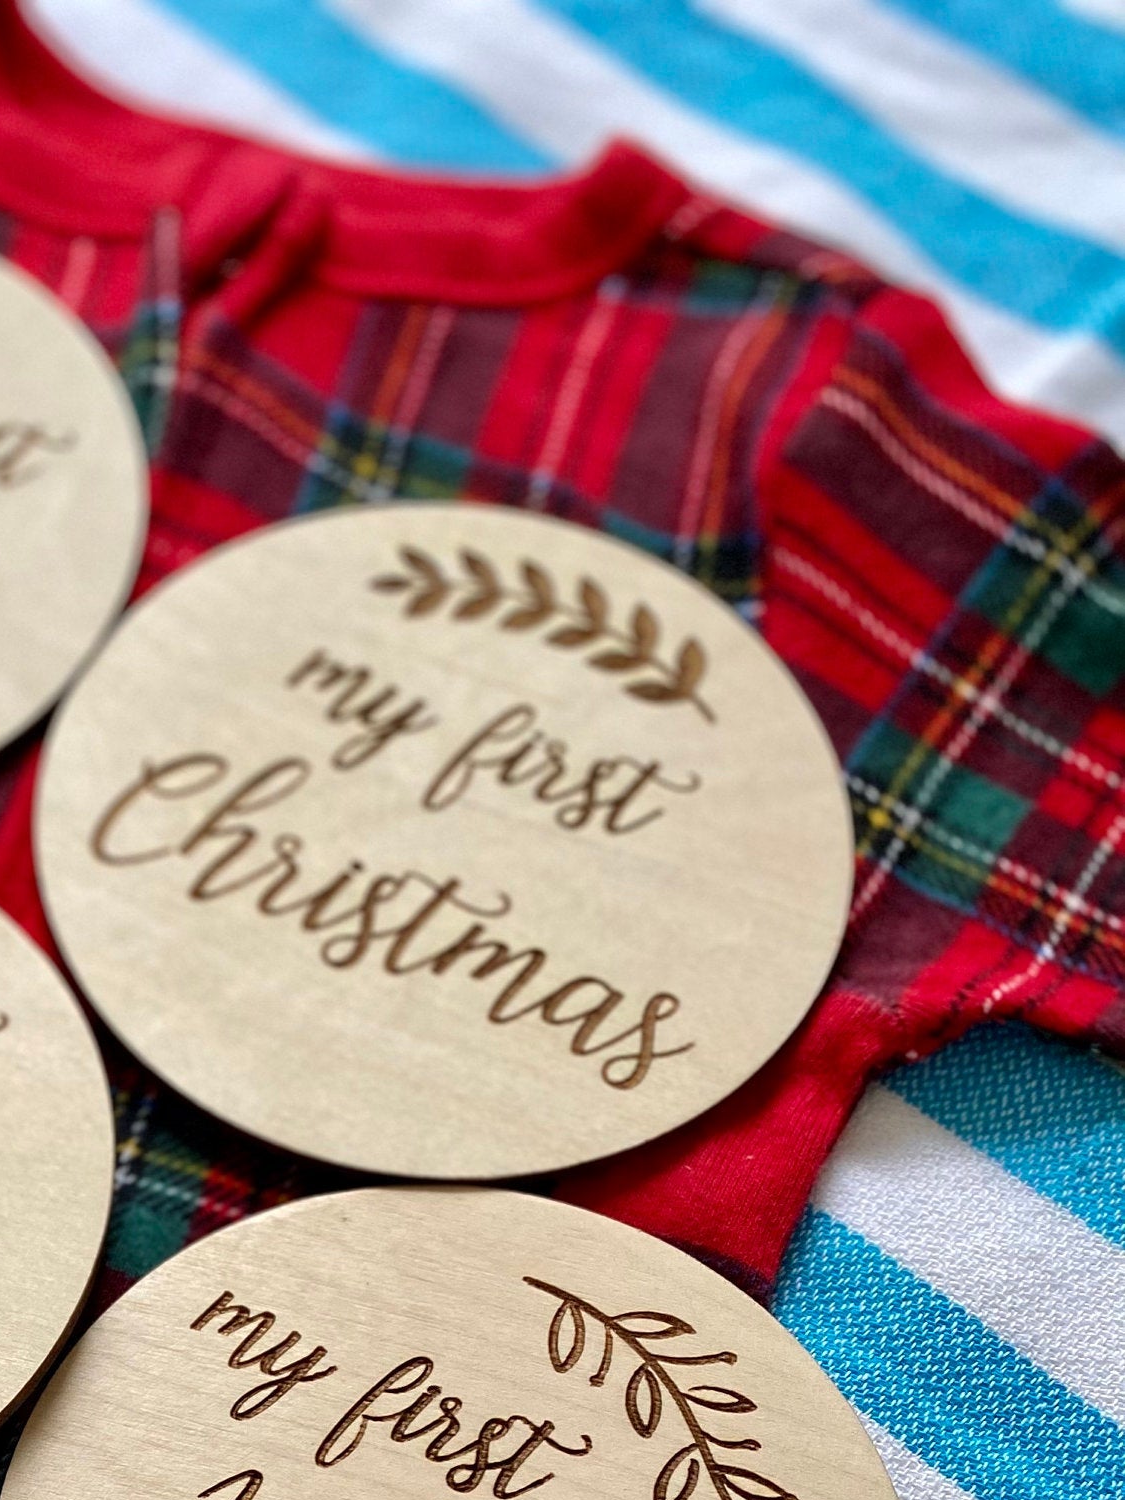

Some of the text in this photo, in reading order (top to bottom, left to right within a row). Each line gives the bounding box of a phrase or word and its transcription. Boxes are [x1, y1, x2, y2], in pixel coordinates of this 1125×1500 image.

[286, 648, 703, 834] my first
[90, 752, 696, 1090] Christmas
[190, 1290, 593, 1500] my first
